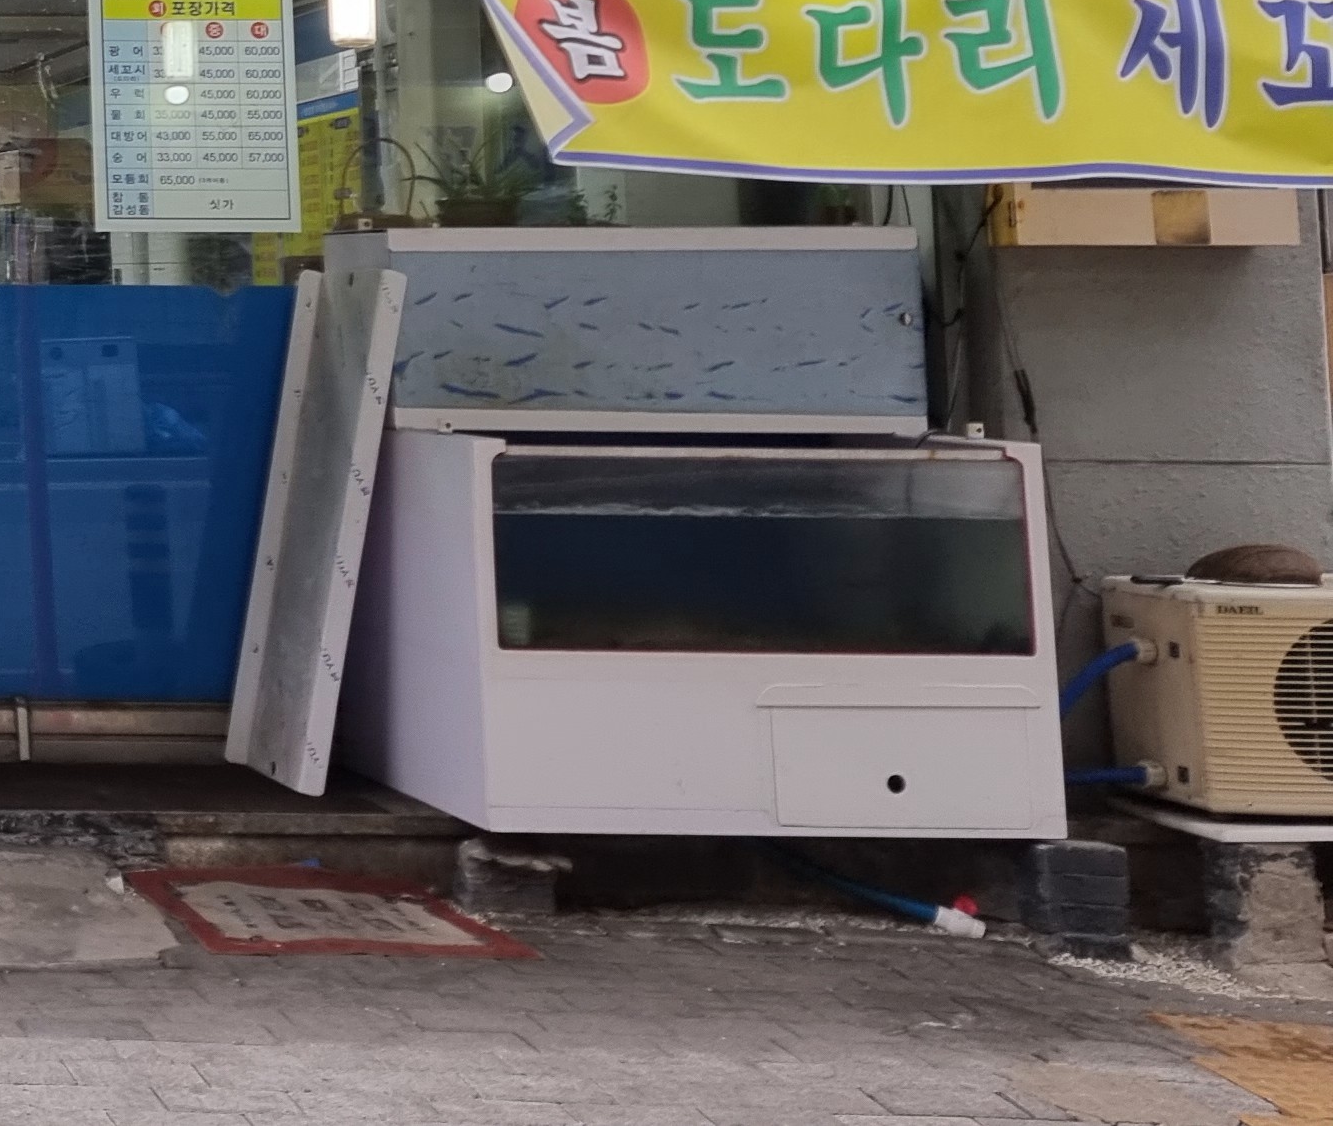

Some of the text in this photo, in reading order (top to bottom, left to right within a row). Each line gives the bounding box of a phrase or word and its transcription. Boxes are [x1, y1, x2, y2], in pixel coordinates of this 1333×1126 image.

[172, 1, 236, 16] 포장가격
[199, 46, 233, 57] 45,000
[245, 46, 280, 57] 60,000
[200, 69, 234, 79] 45,000
[246, 69, 281, 79] 60,000
[201, 89, 235, 100] 45,000
[247, 89, 281, 100] 60,000
[201, 110, 236, 120] 45,000
[247, 110, 282, 120] 55,000
[111, 130, 147, 142] 대방어
[202, 131, 237, 141] 55,000
[203, 153, 238, 163] 45,000
[249, 153, 284, 163] 57,000
[160, 176, 195, 186] 65,000
[210, 199, 234, 211] 싯가
